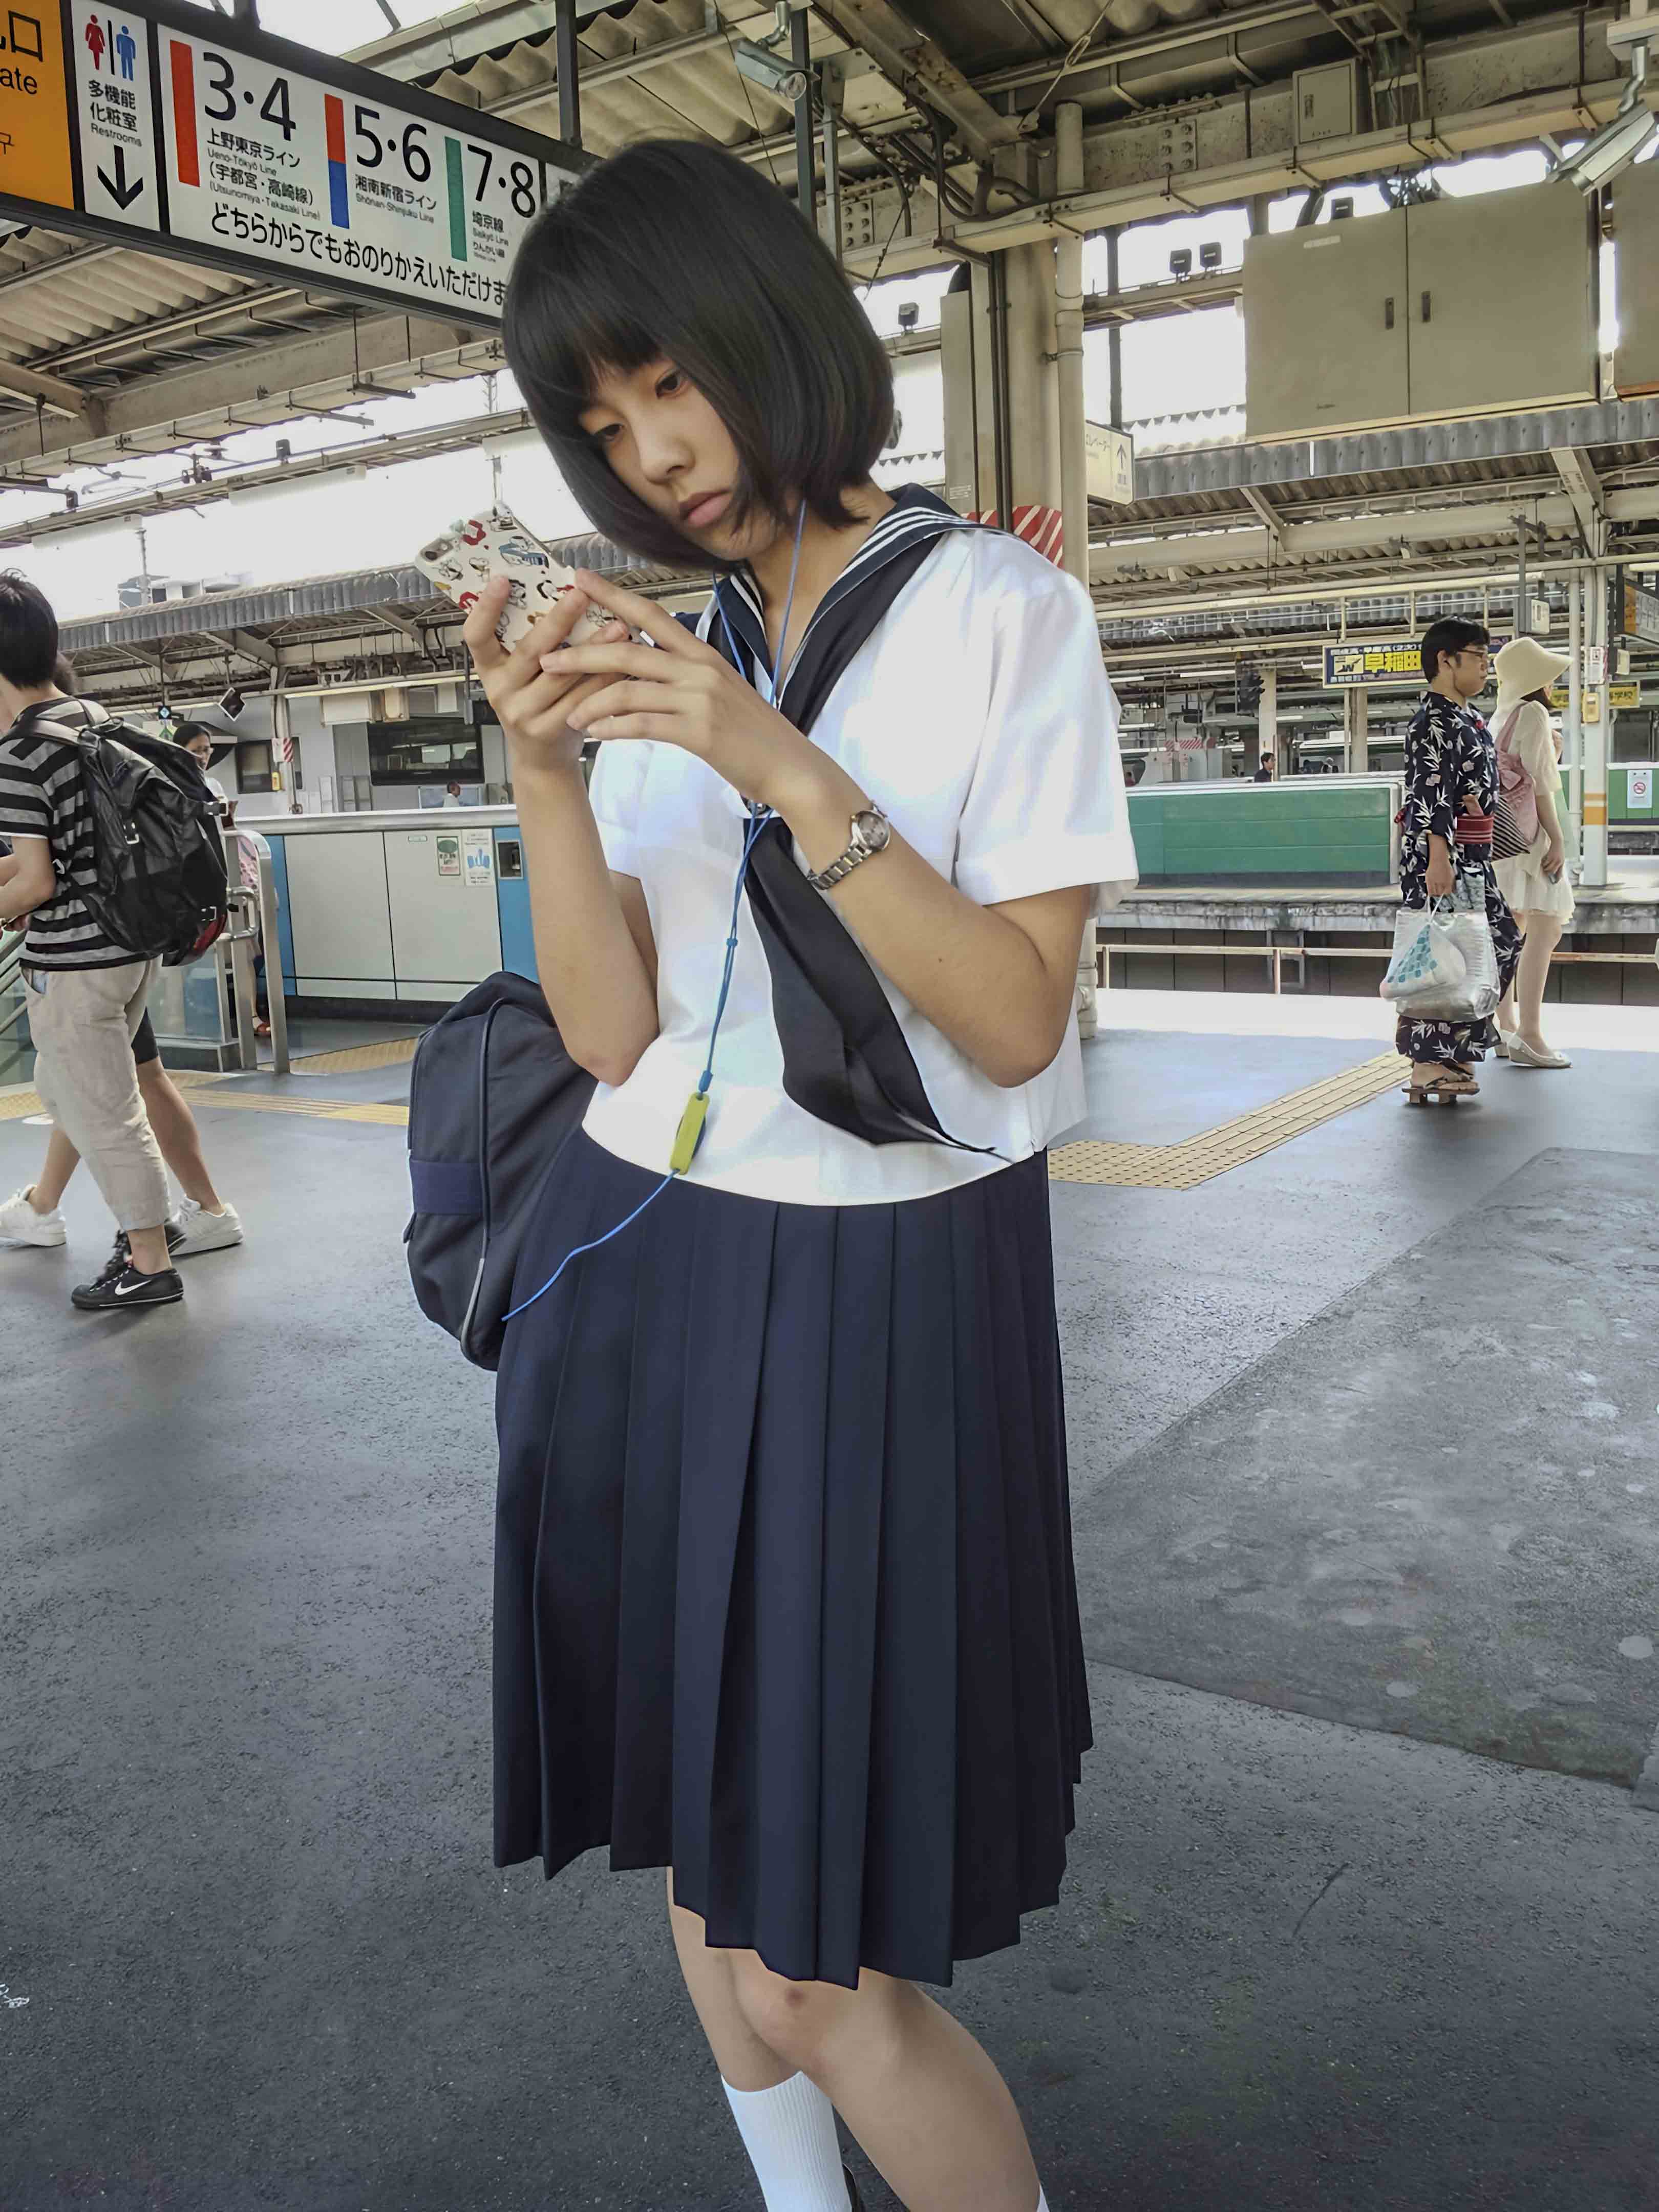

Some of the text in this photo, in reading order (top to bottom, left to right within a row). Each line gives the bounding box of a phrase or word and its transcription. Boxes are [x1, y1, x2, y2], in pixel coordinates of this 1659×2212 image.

[89, 79, 136, 110] 多機能
[90, 102, 138, 133] 化粧室
[91, 123, 142, 147] Restrooms
[207, 127, 300, 168] 上野東京ライン
[260, 163, 277, 176] Line
[355, 174, 436, 210] 湘南新宿ライン
[473, 210, 504, 233] 埼京線
